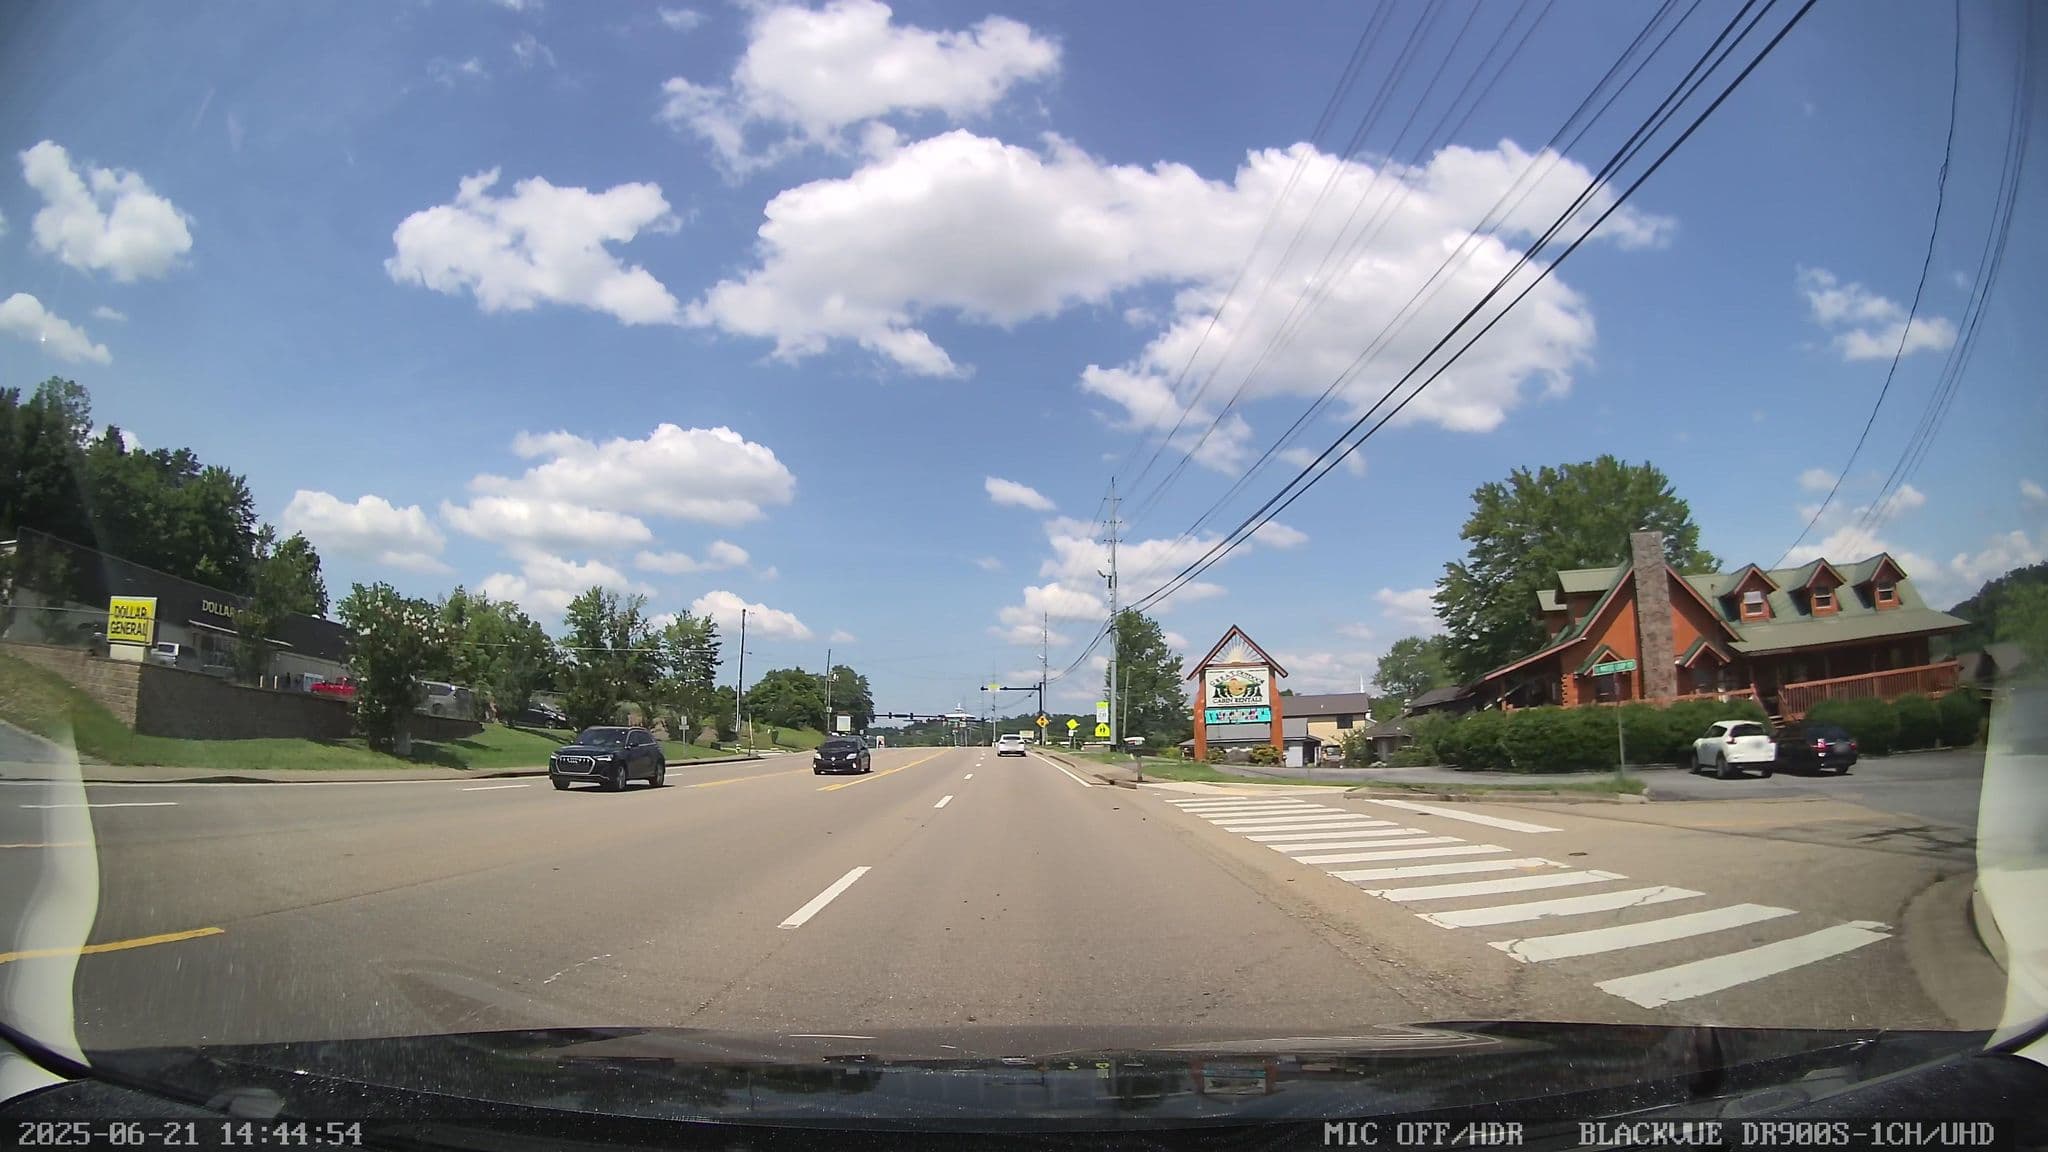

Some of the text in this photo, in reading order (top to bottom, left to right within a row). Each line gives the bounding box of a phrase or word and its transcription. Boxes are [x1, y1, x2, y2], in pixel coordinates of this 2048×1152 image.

[114, 605, 147, 618] DOLLAR
[203, 600, 235, 618] DOLLAR
[111, 621, 147, 636] GENERAL
